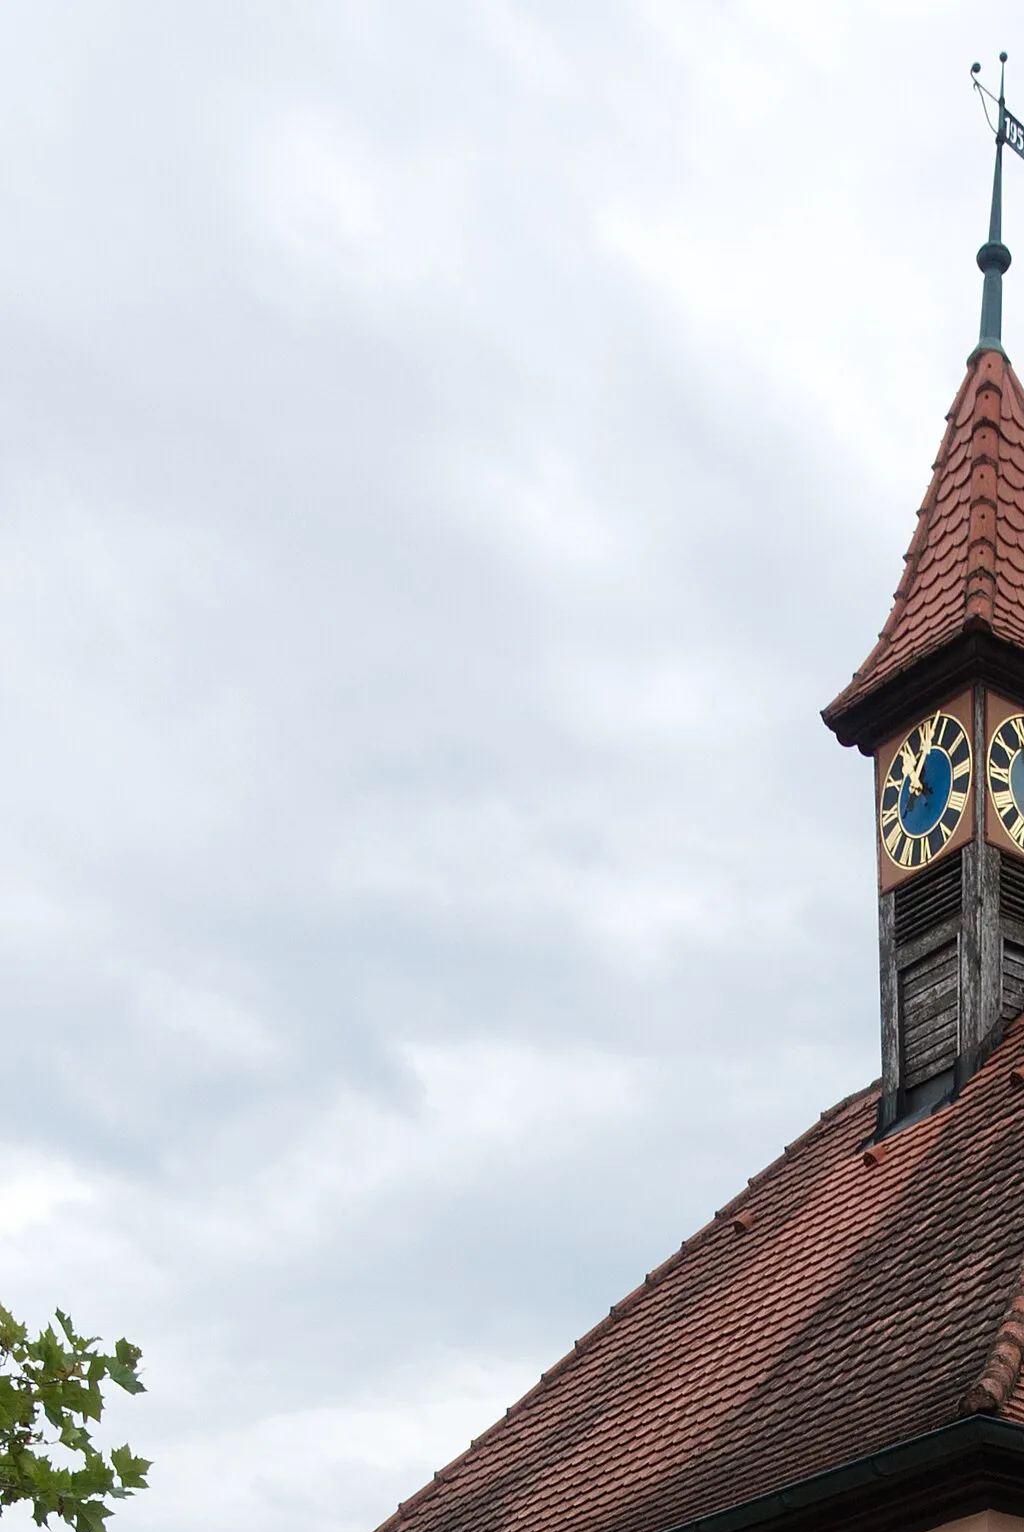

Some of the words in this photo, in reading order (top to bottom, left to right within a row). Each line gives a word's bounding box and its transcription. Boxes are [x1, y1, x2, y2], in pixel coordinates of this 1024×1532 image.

[937, 718, 948, 745] I
[948, 730, 964, 756] II
[995, 731, 1014, 760] X
[953, 758, 970, 780] III
